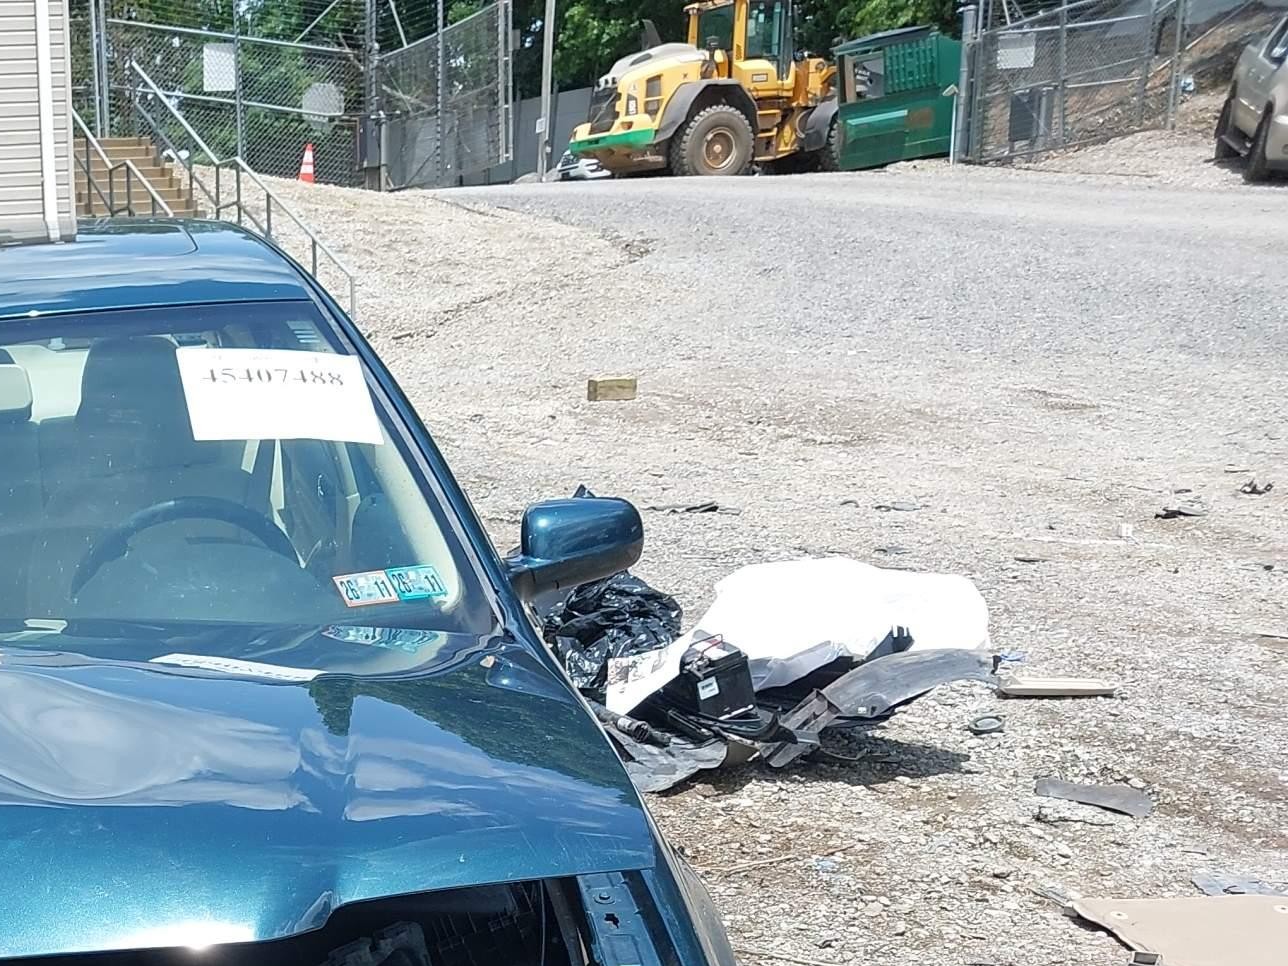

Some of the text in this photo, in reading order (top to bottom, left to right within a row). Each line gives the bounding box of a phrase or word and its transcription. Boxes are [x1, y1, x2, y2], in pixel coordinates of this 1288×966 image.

[202, 368, 344, 386] 45407488
[340, 580, 392, 601] 26 11
[392, 573, 443, 593] 26 11
